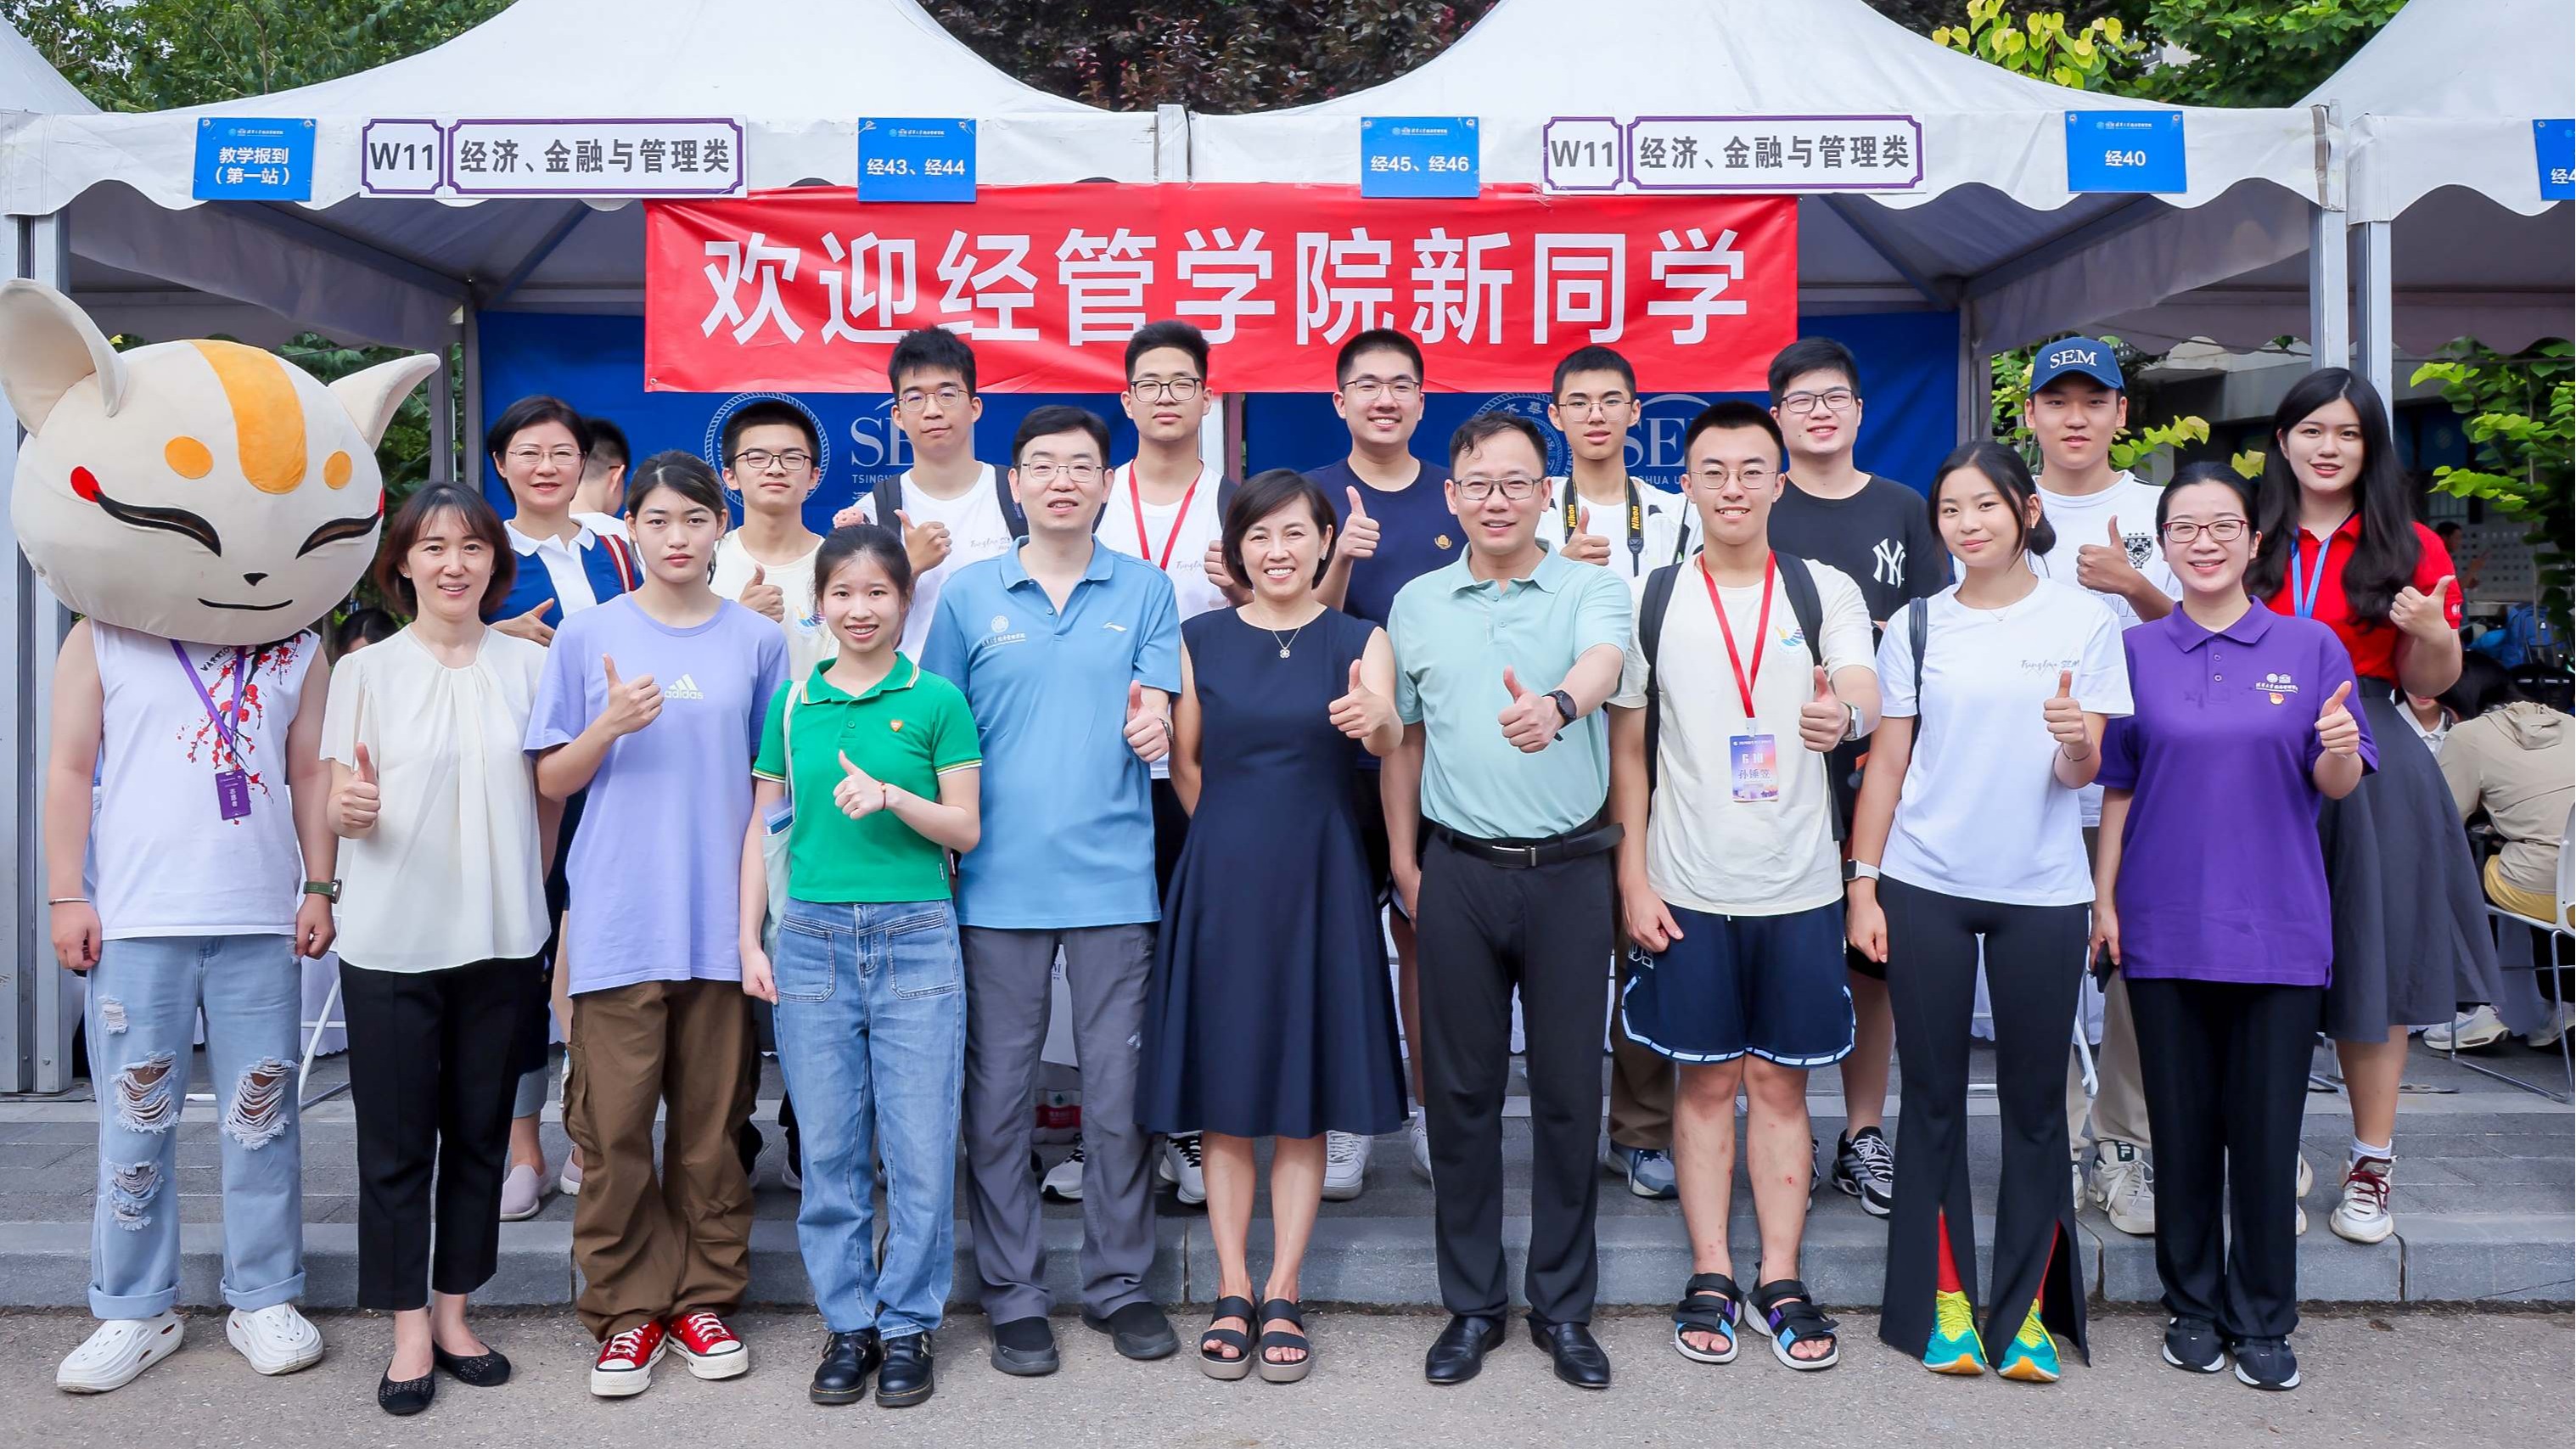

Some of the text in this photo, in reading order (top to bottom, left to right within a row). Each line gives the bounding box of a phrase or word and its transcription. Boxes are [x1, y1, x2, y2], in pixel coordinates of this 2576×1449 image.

[219, 147, 289, 165] 教学报到
[369, 142, 434, 171] W11
[460, 138, 729, 173] 经济、金融与管理类
[1371, 155, 1469, 171] 经45、经46
[1551, 140, 1614, 167] W11
[1640, 134, 1910, 169] 经济、金融与管理类
[2105, 150, 2147, 166] 经40
[867, 158, 965, 175] 经43、经44
[700, 227, 1747, 345] 欢迎经管学院新同学
[2050, 349, 2097, 369] SEM
[1568, 504, 1577, 528] Nikon
[1631, 505, 1641, 530] Nikon
[665, 687, 704, 700] adidas
